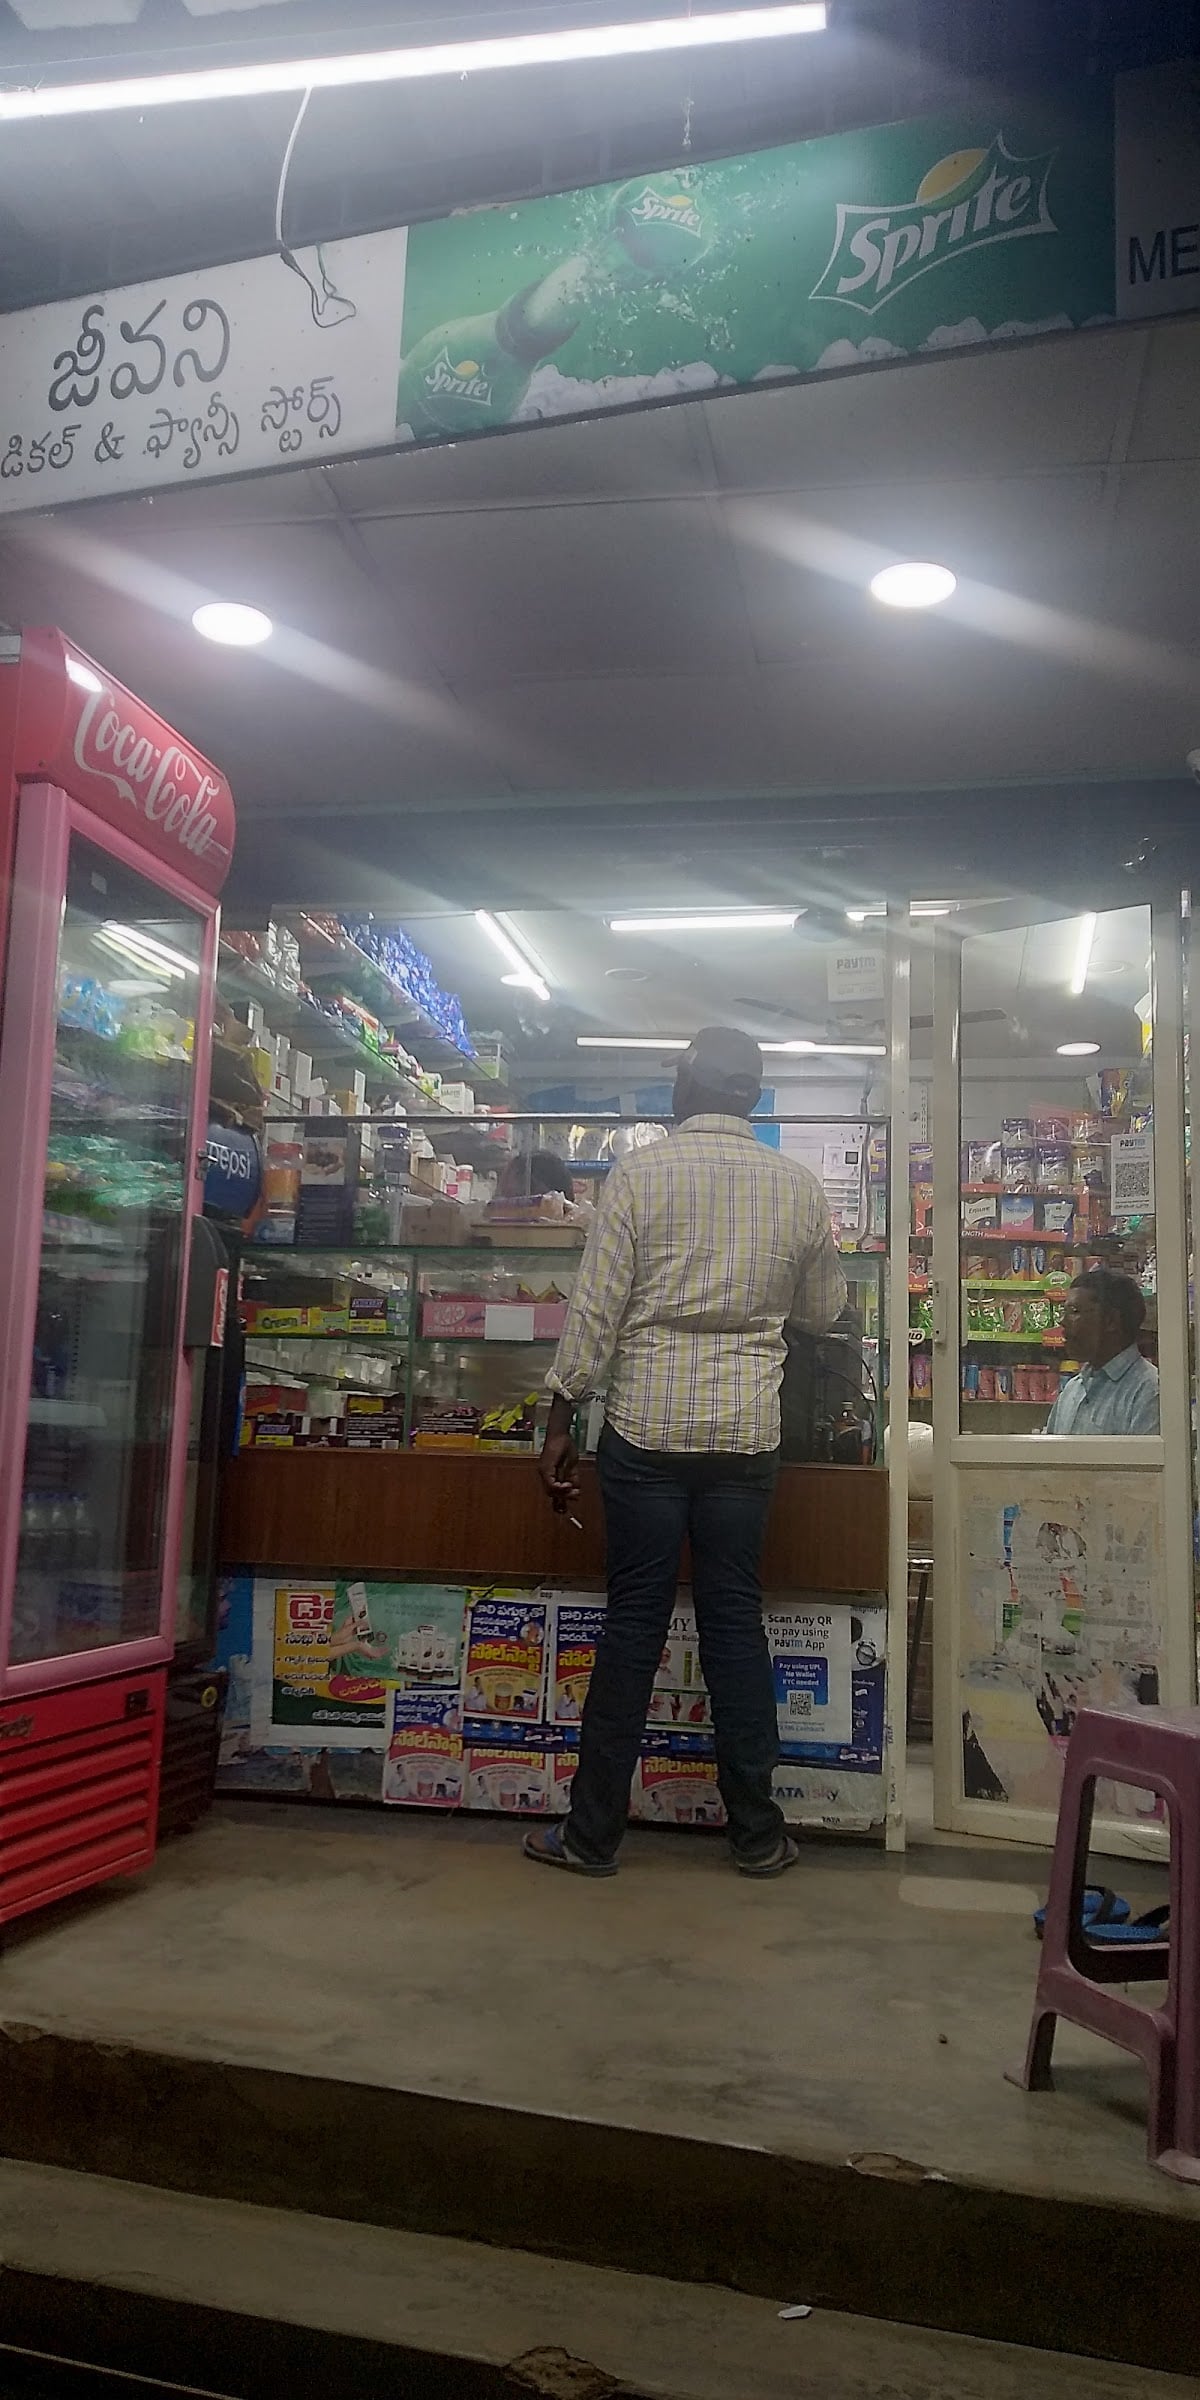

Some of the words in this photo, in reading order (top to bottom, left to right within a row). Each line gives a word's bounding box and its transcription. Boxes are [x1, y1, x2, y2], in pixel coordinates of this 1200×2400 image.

[636, 195, 701, 228] Sprite
[837, 162, 1032, 294] Sprite
[48, 299, 231, 412] జీవని
[425, 360, 489, 397] Sprite
[94, 421, 125, 463] &
[146, 391, 240, 469] ఫ్యాన్సీ
[261, 376, 342, 450] స్టోర్స్
[208, 1145, 251, 1180] pepsi
[262, 1316, 298, 1330] Cream
[768, 1614, 792, 1624] Scan
[795, 1615, 815, 1626] Any
[817, 1616, 833, 1625] QR
[769, 1628, 779, 1636] to
[782, 1629, 800, 1638] pay
[802, 1629, 830, 1639] using
[806, 1640, 825, 1651] App
[779, 1662, 791, 1671] Pay
[792, 1663, 809, 1671] using
[796, 1678, 819, 1686] needed
